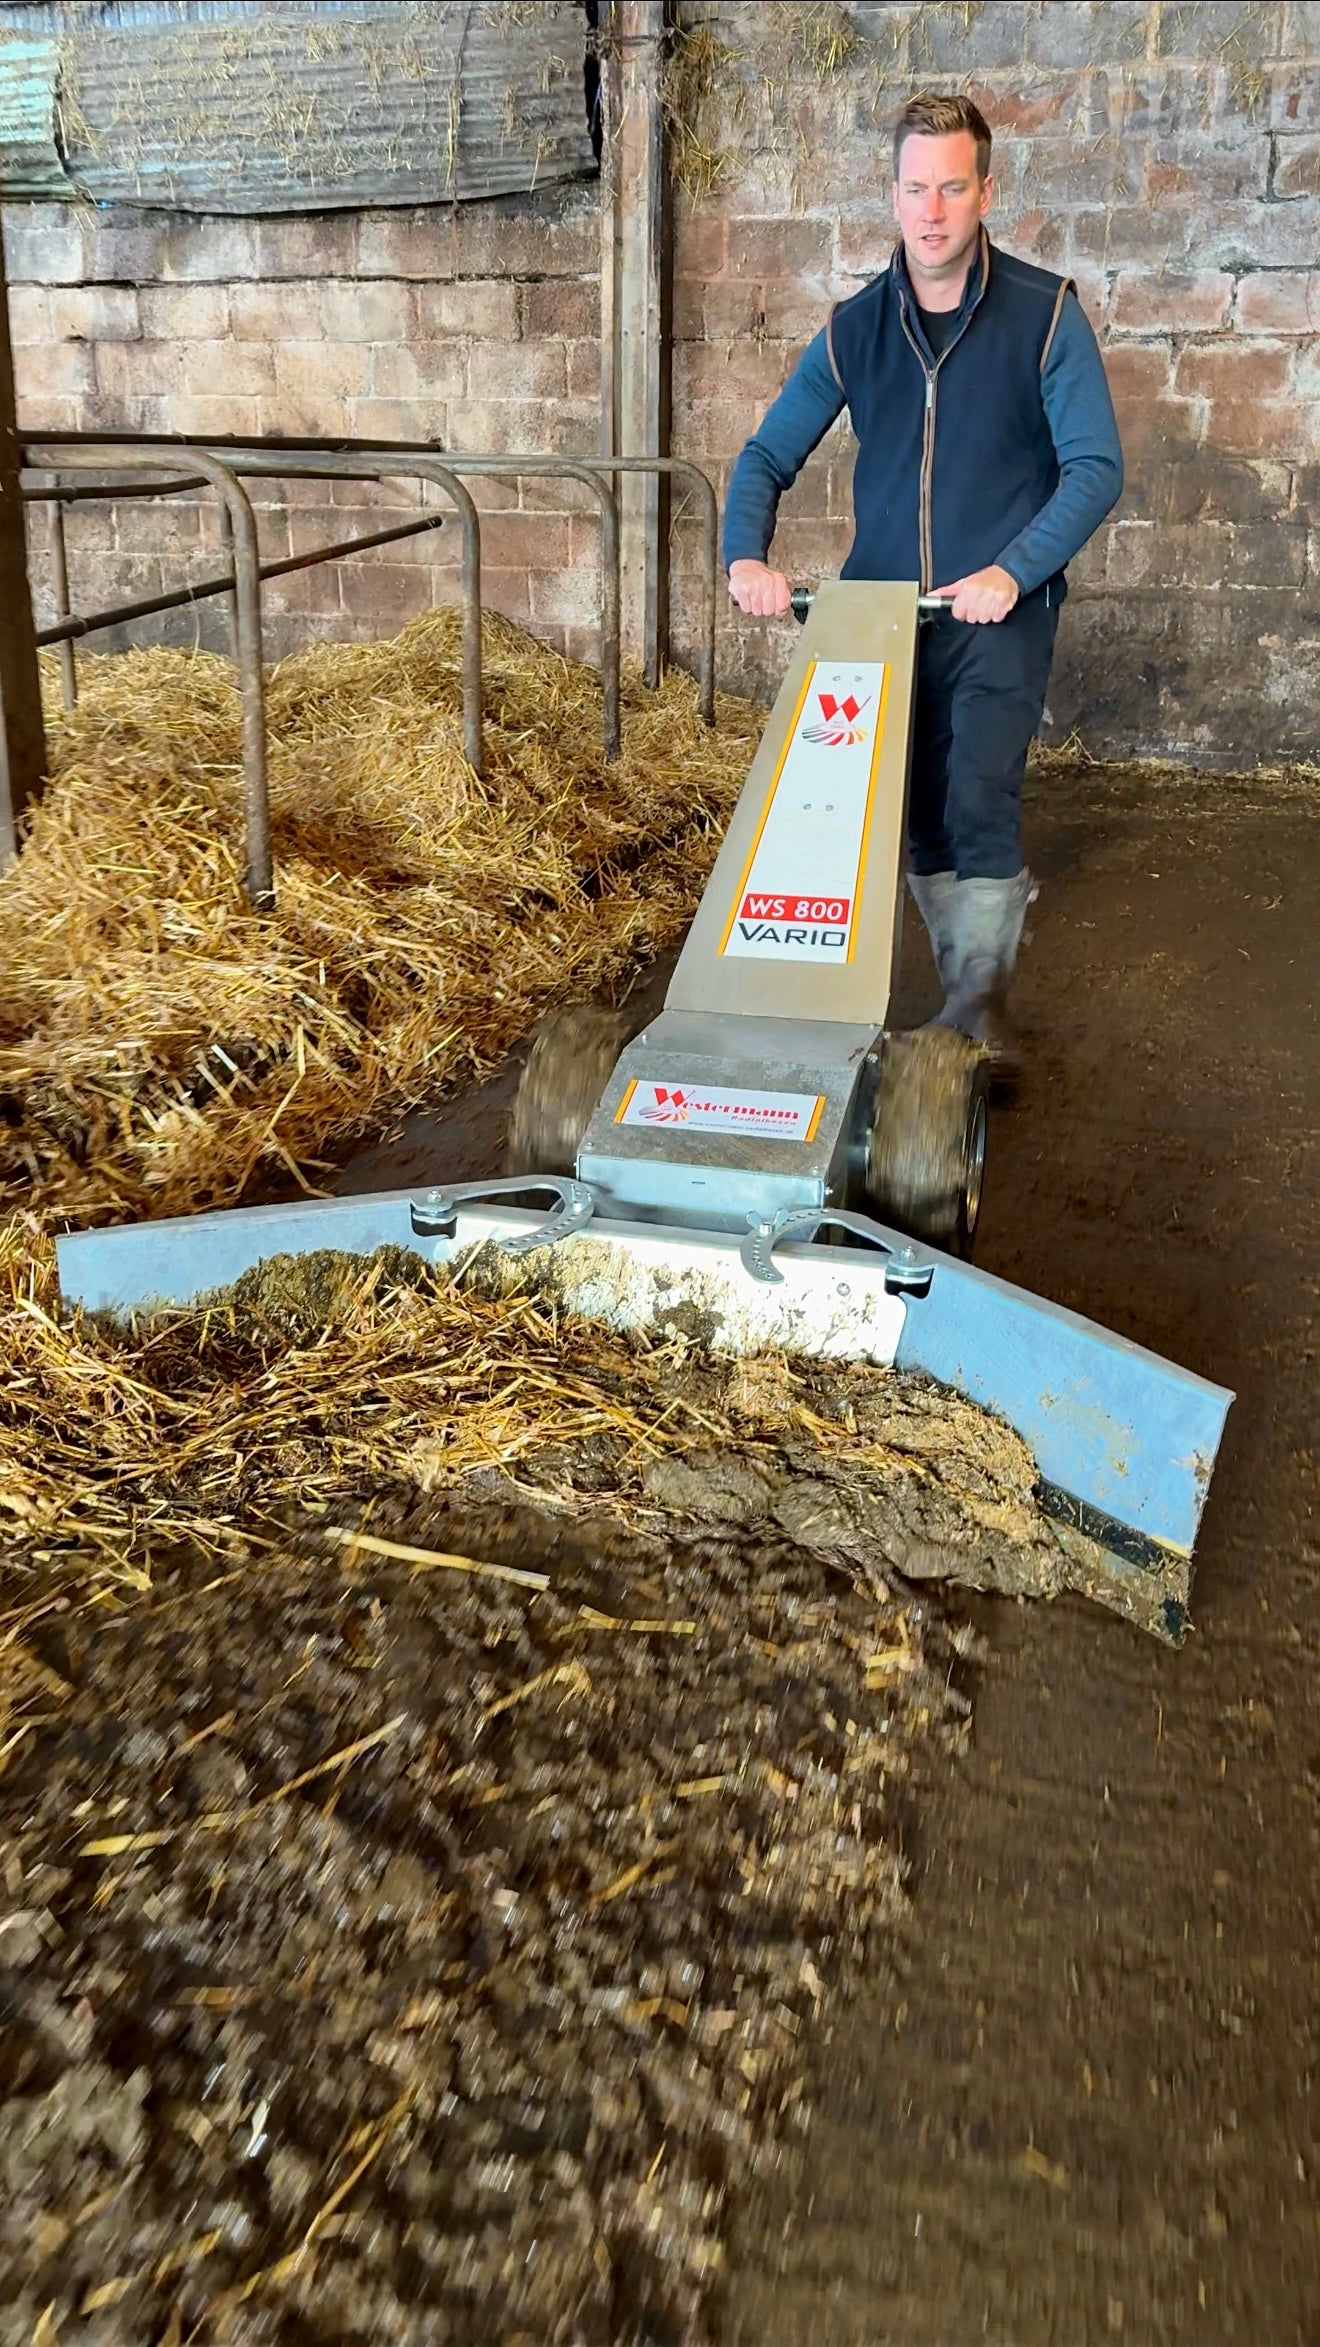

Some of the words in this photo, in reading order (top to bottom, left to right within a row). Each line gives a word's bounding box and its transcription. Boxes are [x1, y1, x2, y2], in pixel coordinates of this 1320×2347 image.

[818, 694, 871, 722] W
[749, 897, 786, 917] WS
[794, 900, 843, 920] 800
[738, 922, 846, 947] VARIO
[654, 1087, 799, 1120] Westermann
